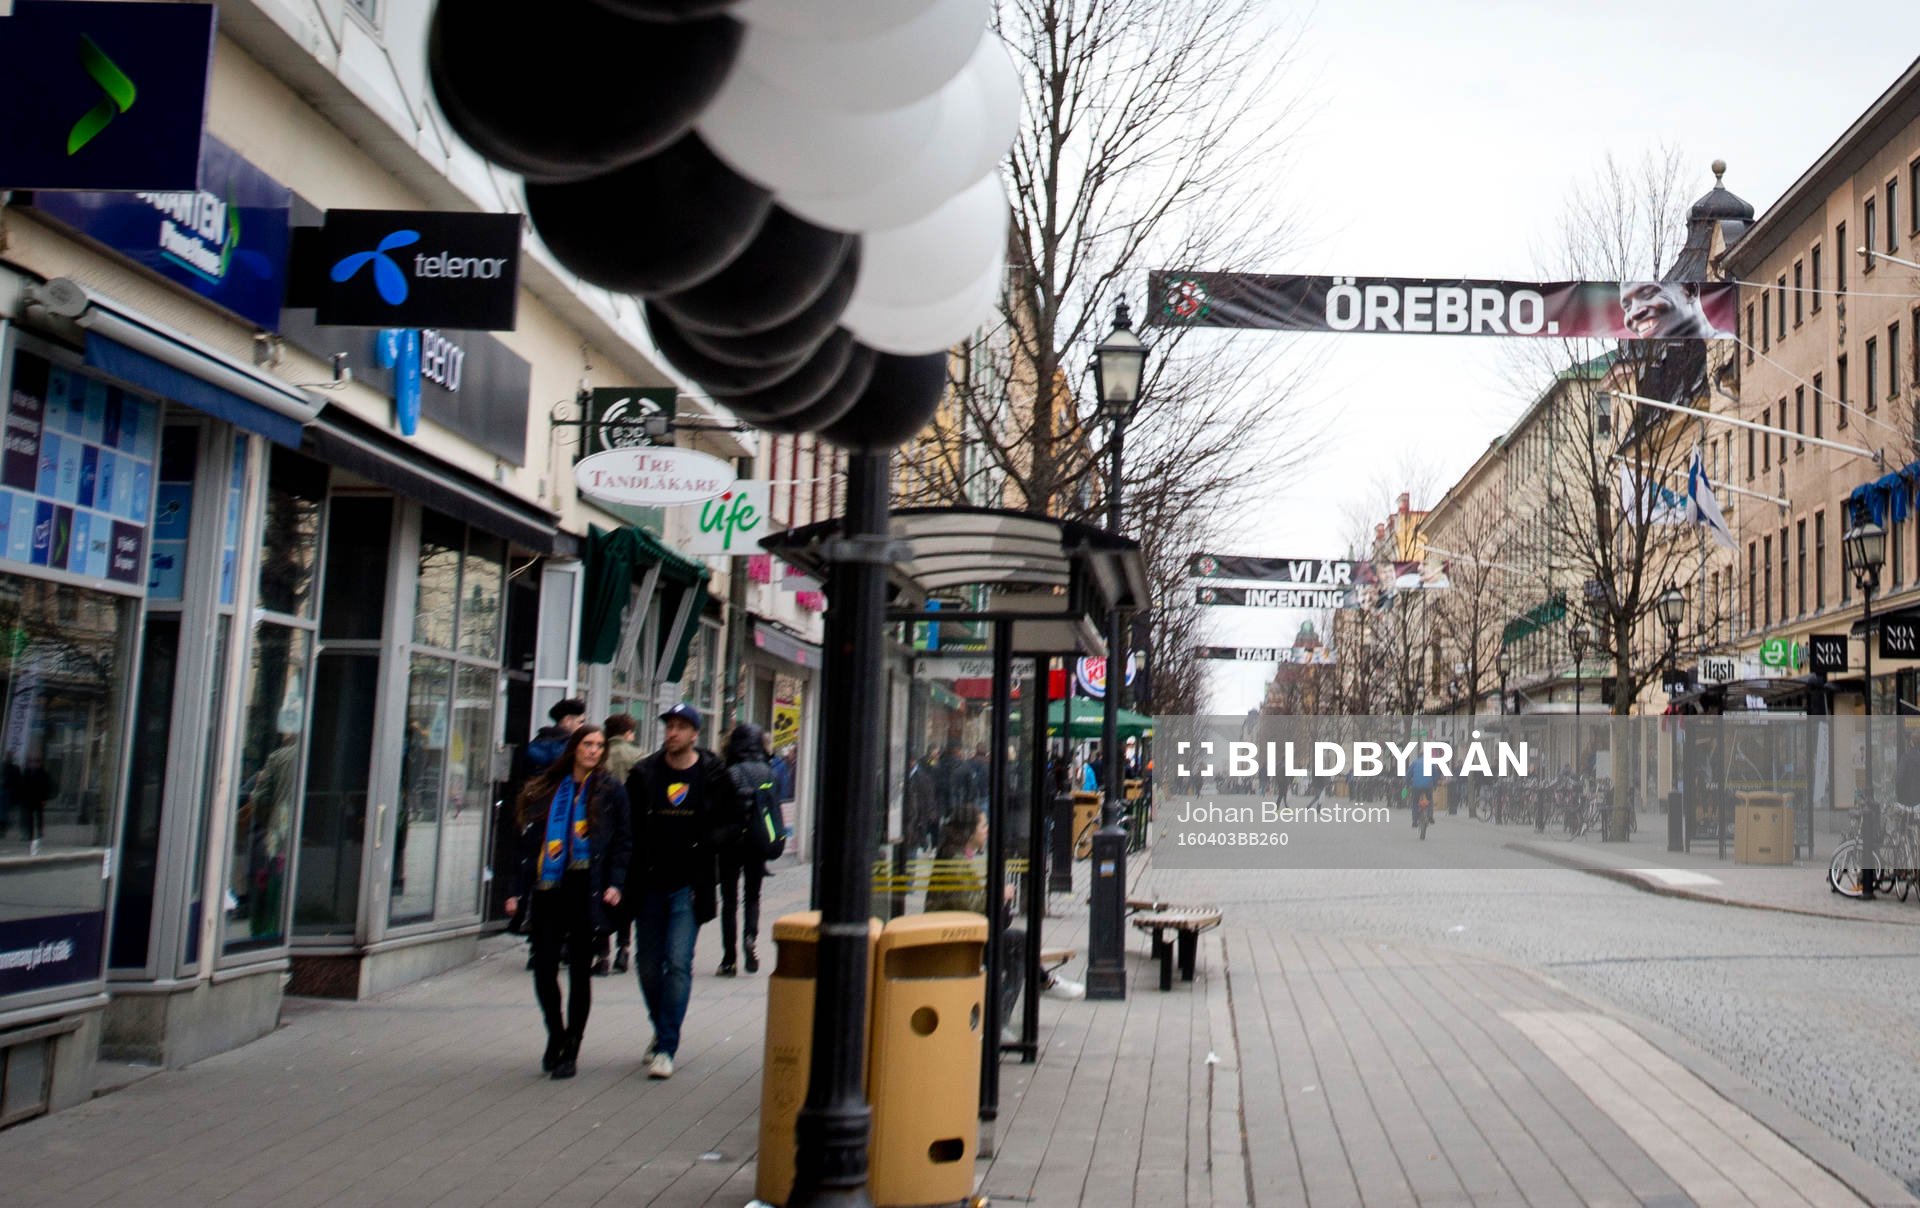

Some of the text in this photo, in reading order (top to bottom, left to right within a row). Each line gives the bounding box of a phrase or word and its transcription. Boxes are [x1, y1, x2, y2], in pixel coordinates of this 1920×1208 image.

[414, 251, 508, 279] telenor
[1325, 276, 1560, 335] ÖREBRO.
[1288, 558, 1351, 585] VI ÄR
[1245, 589, 1345, 608] INGENTING
[1703, 659, 1735, 681] flash
